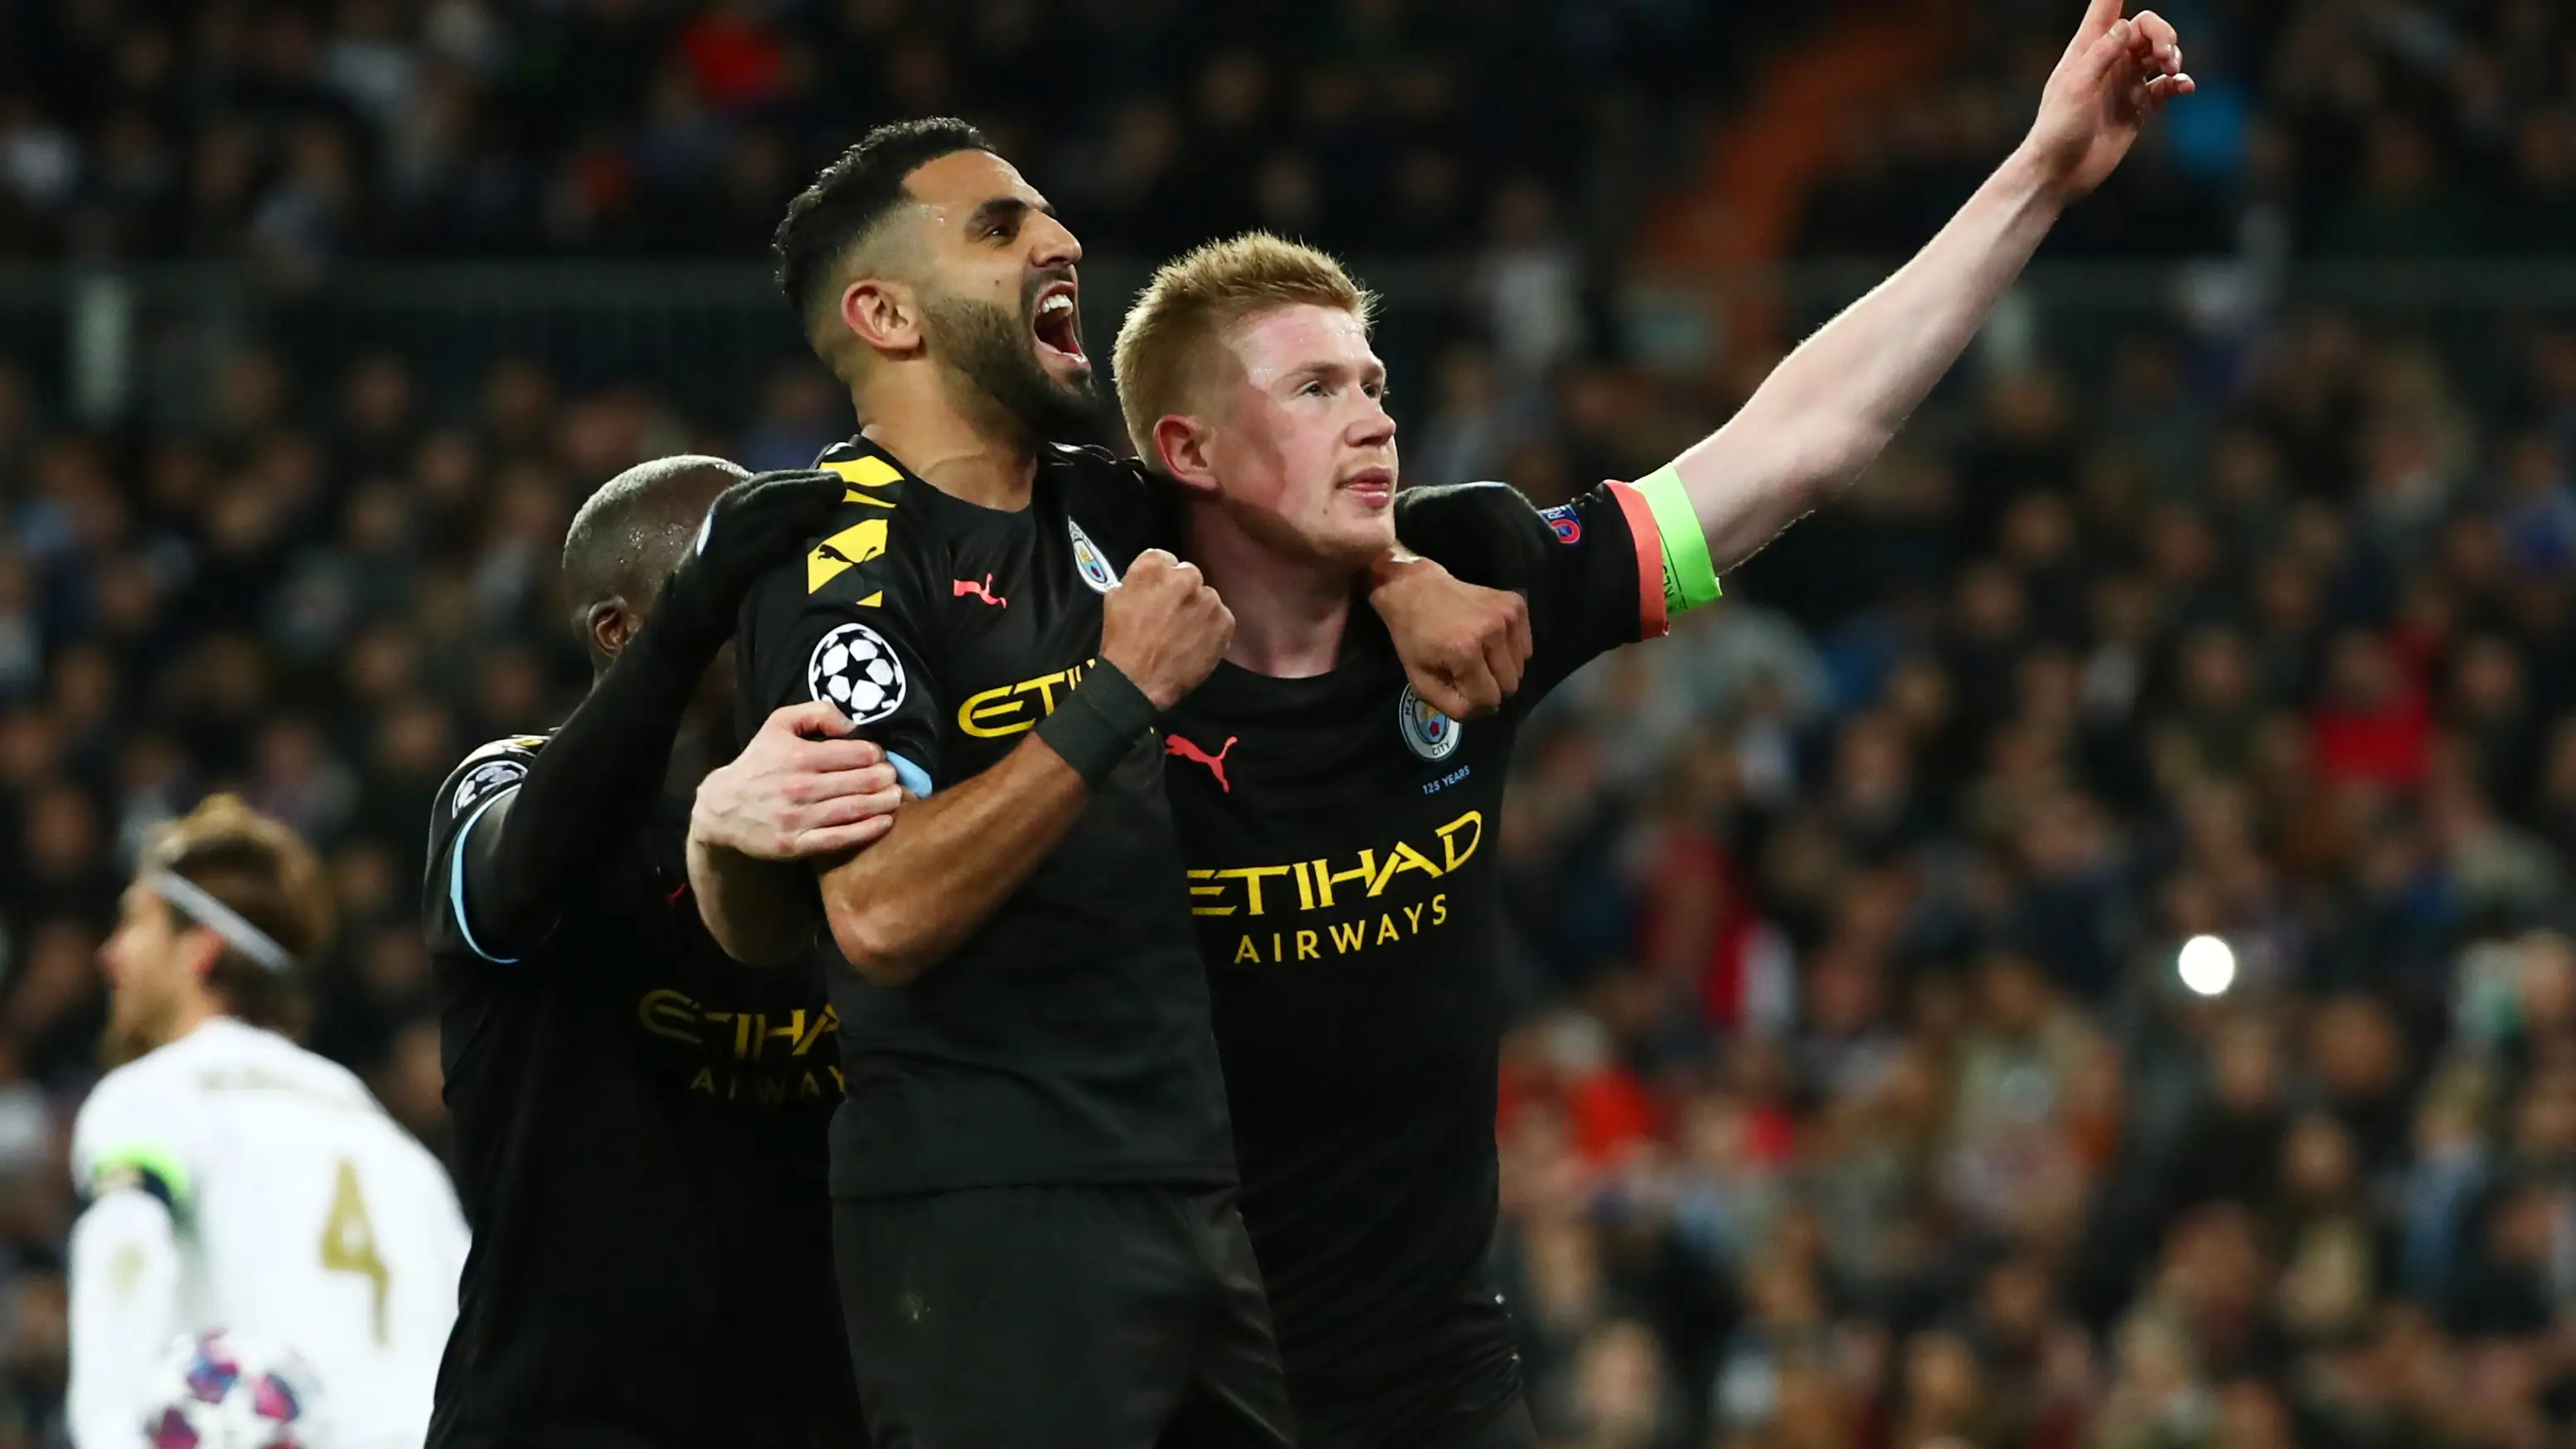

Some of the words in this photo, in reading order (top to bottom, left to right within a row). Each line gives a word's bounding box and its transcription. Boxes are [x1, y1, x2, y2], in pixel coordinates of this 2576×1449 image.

[1423, 781, 1440, 795] 125
[1442, 765, 1471, 788] YEARS
[1432, 739, 1450, 756] CITY
[1186, 810, 1482, 916] ETIHAD
[1234, 893, 1448, 964] AIRWAYS
[319, 1156, 390, 1351] 4
